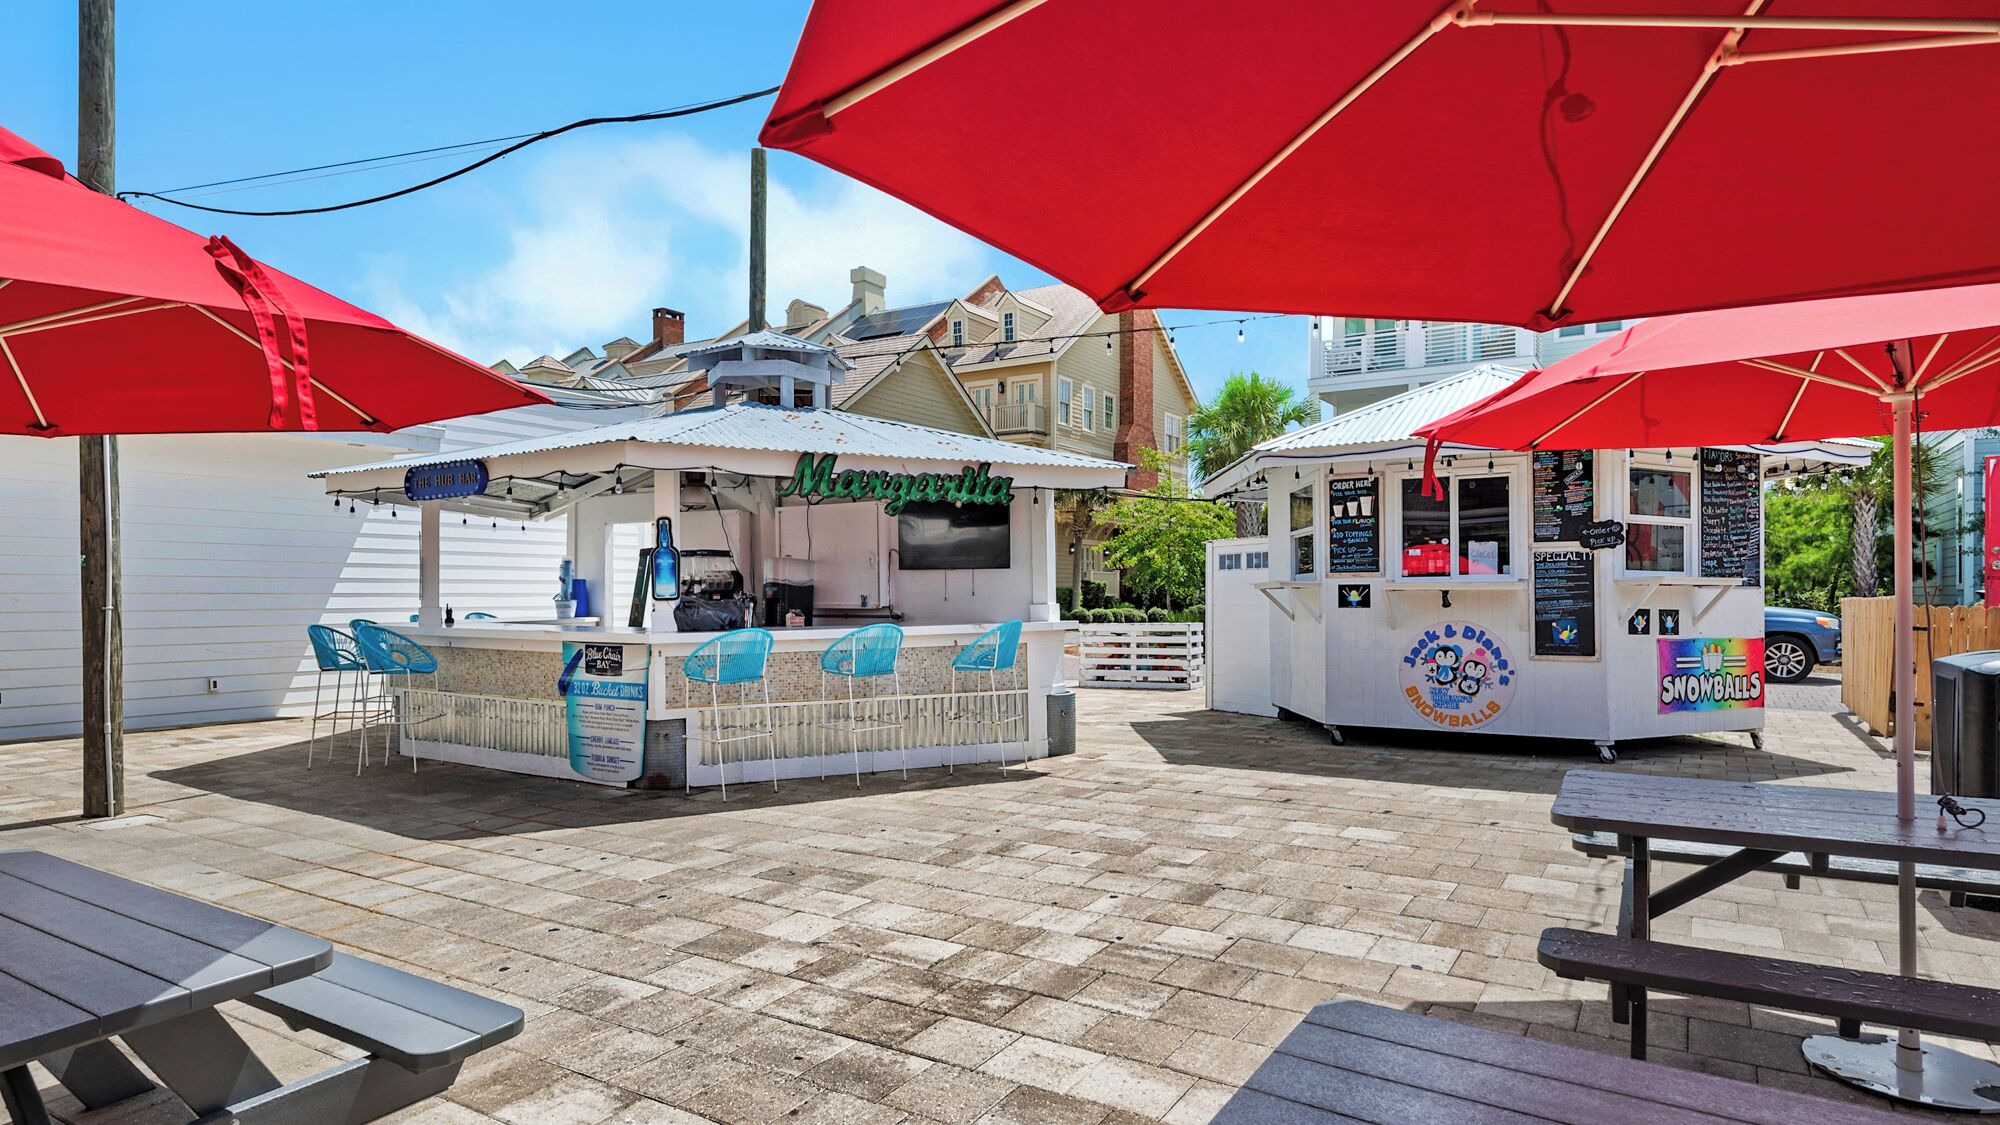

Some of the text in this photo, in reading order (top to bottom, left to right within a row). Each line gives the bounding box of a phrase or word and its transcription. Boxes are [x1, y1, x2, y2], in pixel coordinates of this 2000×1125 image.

[414, 472, 478, 488] THE HUB BAR
[776, 452, 1015, 517] Margarita
[1332, 479, 1372, 490] ORDER HERE
[1345, 530, 1373, 538] TOPPINGS
[1589, 527, 1611, 535] Order
[1590, 538, 1604, 546] Pick
[1333, 546, 1346, 554] PICK
[1535, 551, 1594, 561] SPECIALTY
[586, 647, 622, 662] Blue Chair
[1404, 624, 1515, 686] Jack & Diane's
[597, 661, 611, 669] BAY
[574, 682, 643, 699] 32 OZ Bucket DRINKS
[1429, 687, 1450, 695] NEW
[1660, 672, 1762, 705] SNOWBALLS
[1405, 685, 1502, 727] SNOWBALLS
